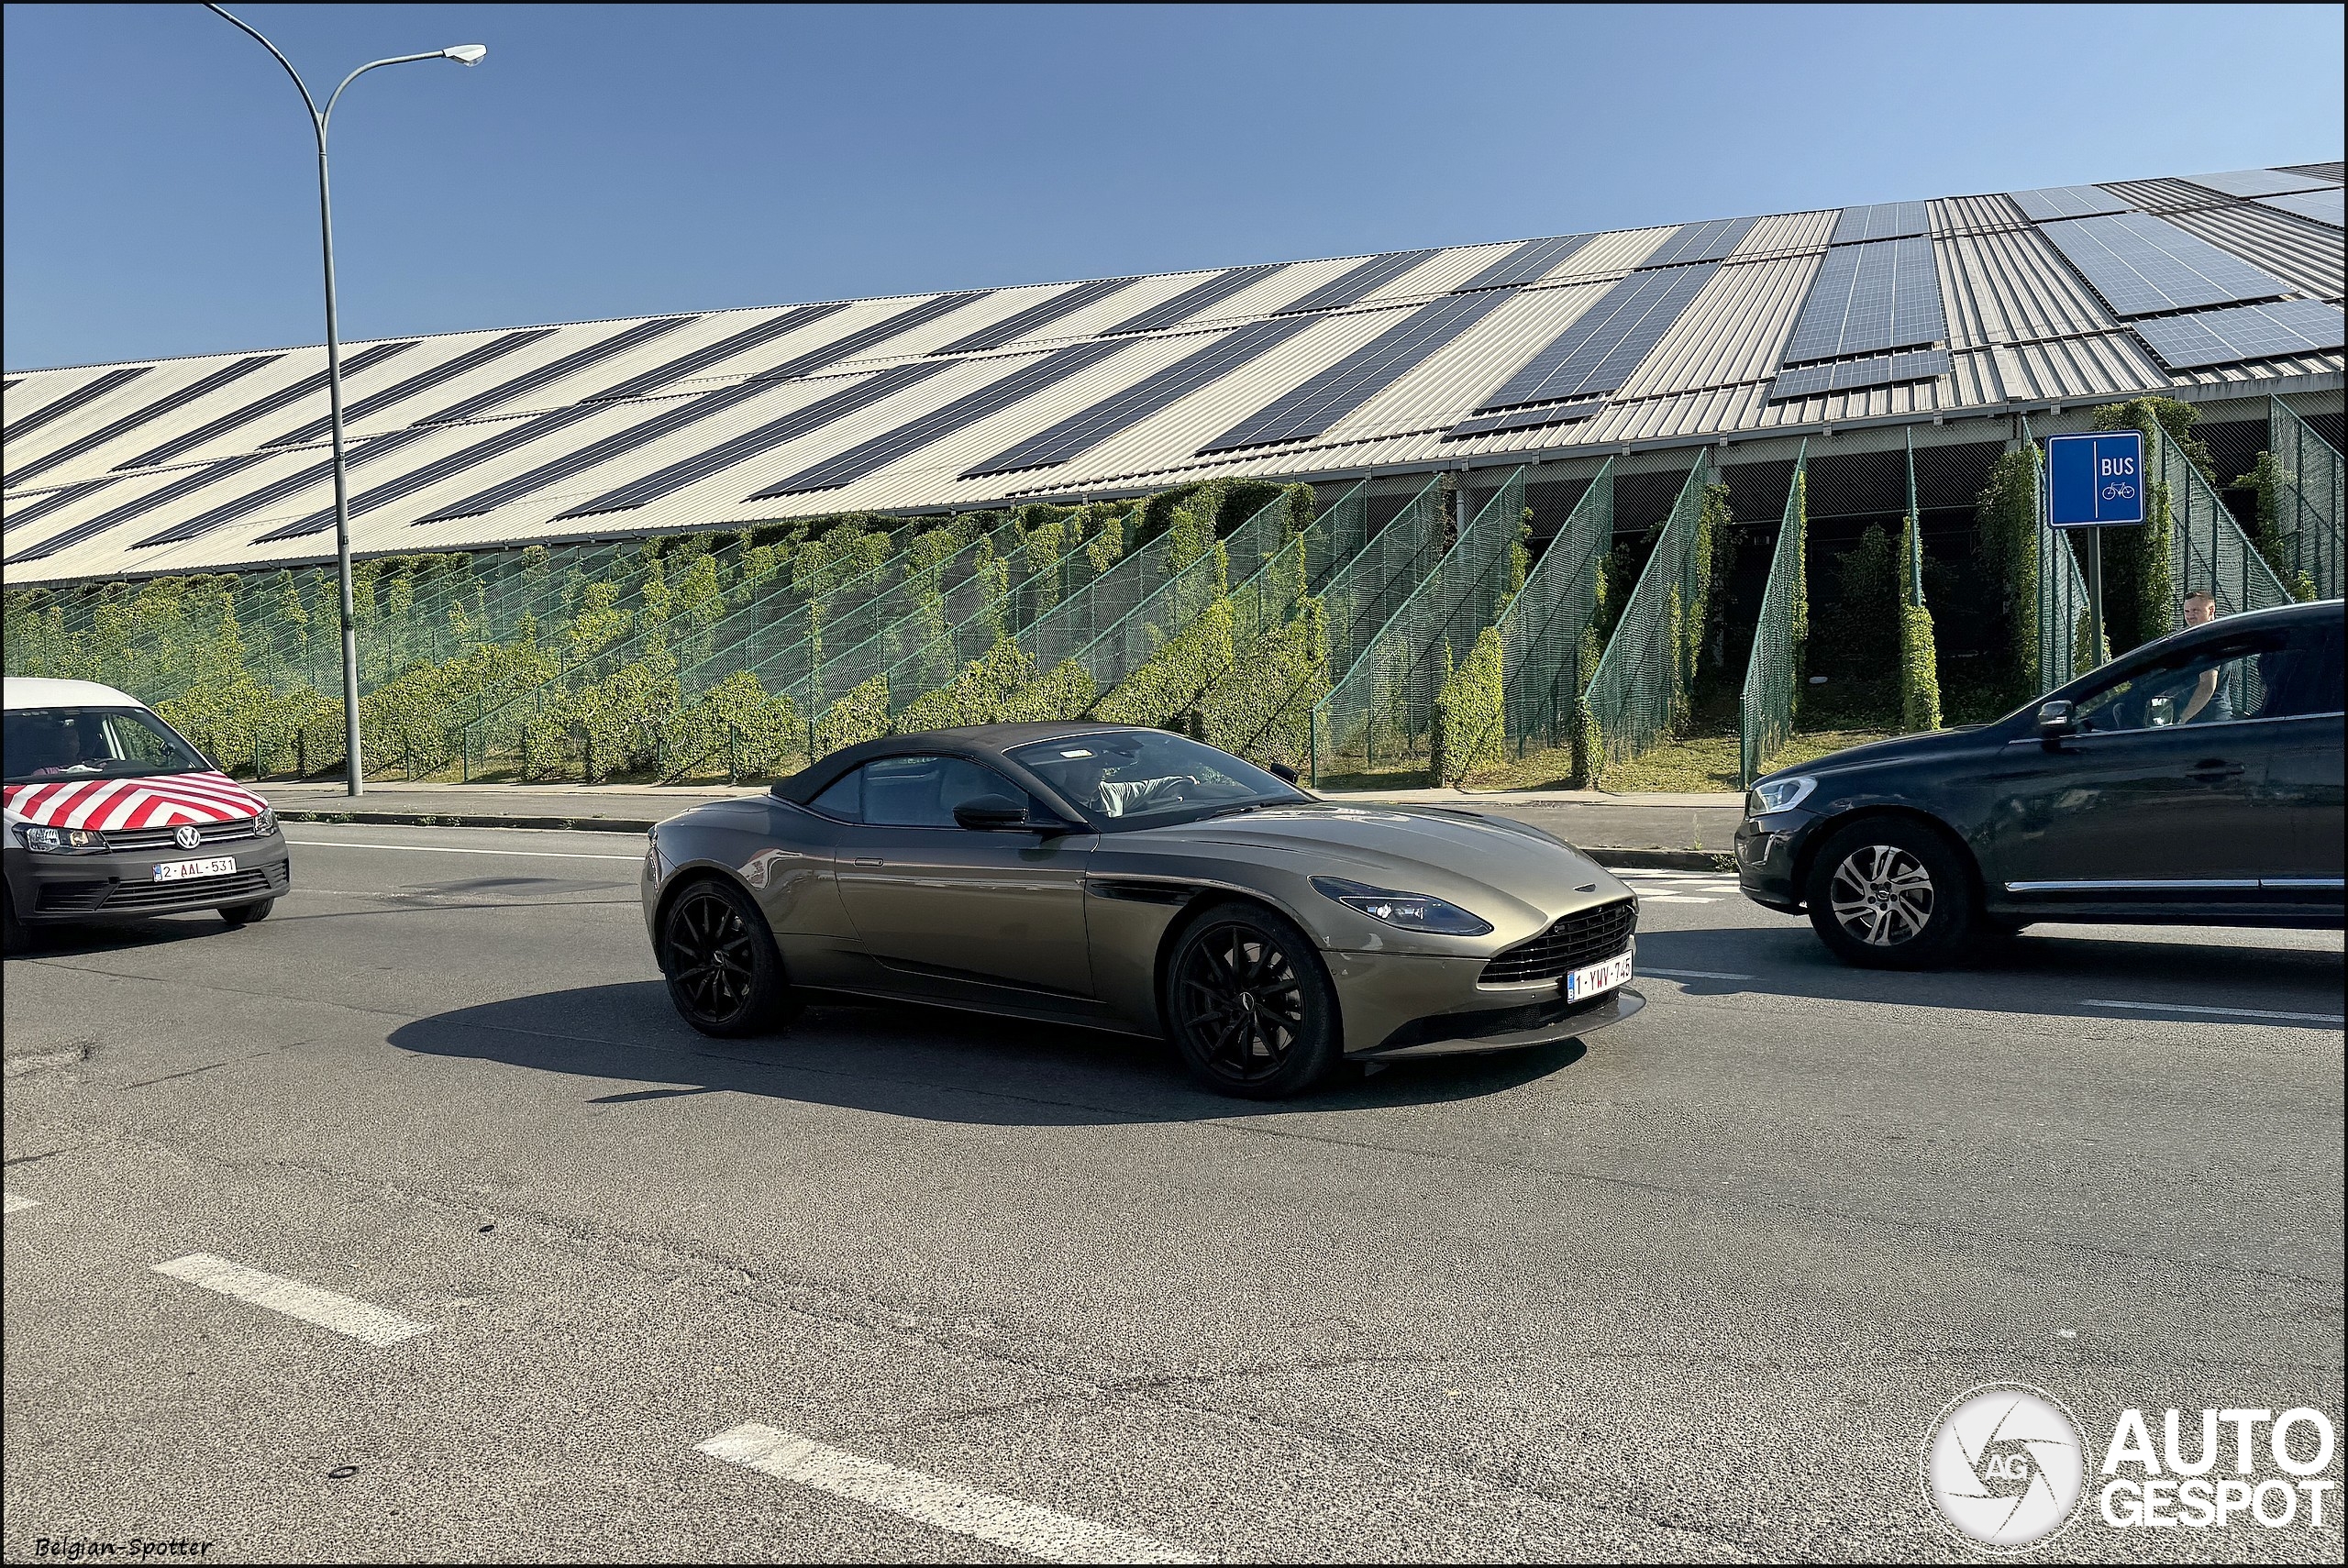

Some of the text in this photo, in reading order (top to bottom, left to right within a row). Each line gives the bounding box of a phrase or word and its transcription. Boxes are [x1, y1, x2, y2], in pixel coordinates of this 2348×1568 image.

[2101, 457, 2134, 476] BUS
[178, 827, 200, 848] VW
[163, 859, 234, 878] 2-AAL-531
